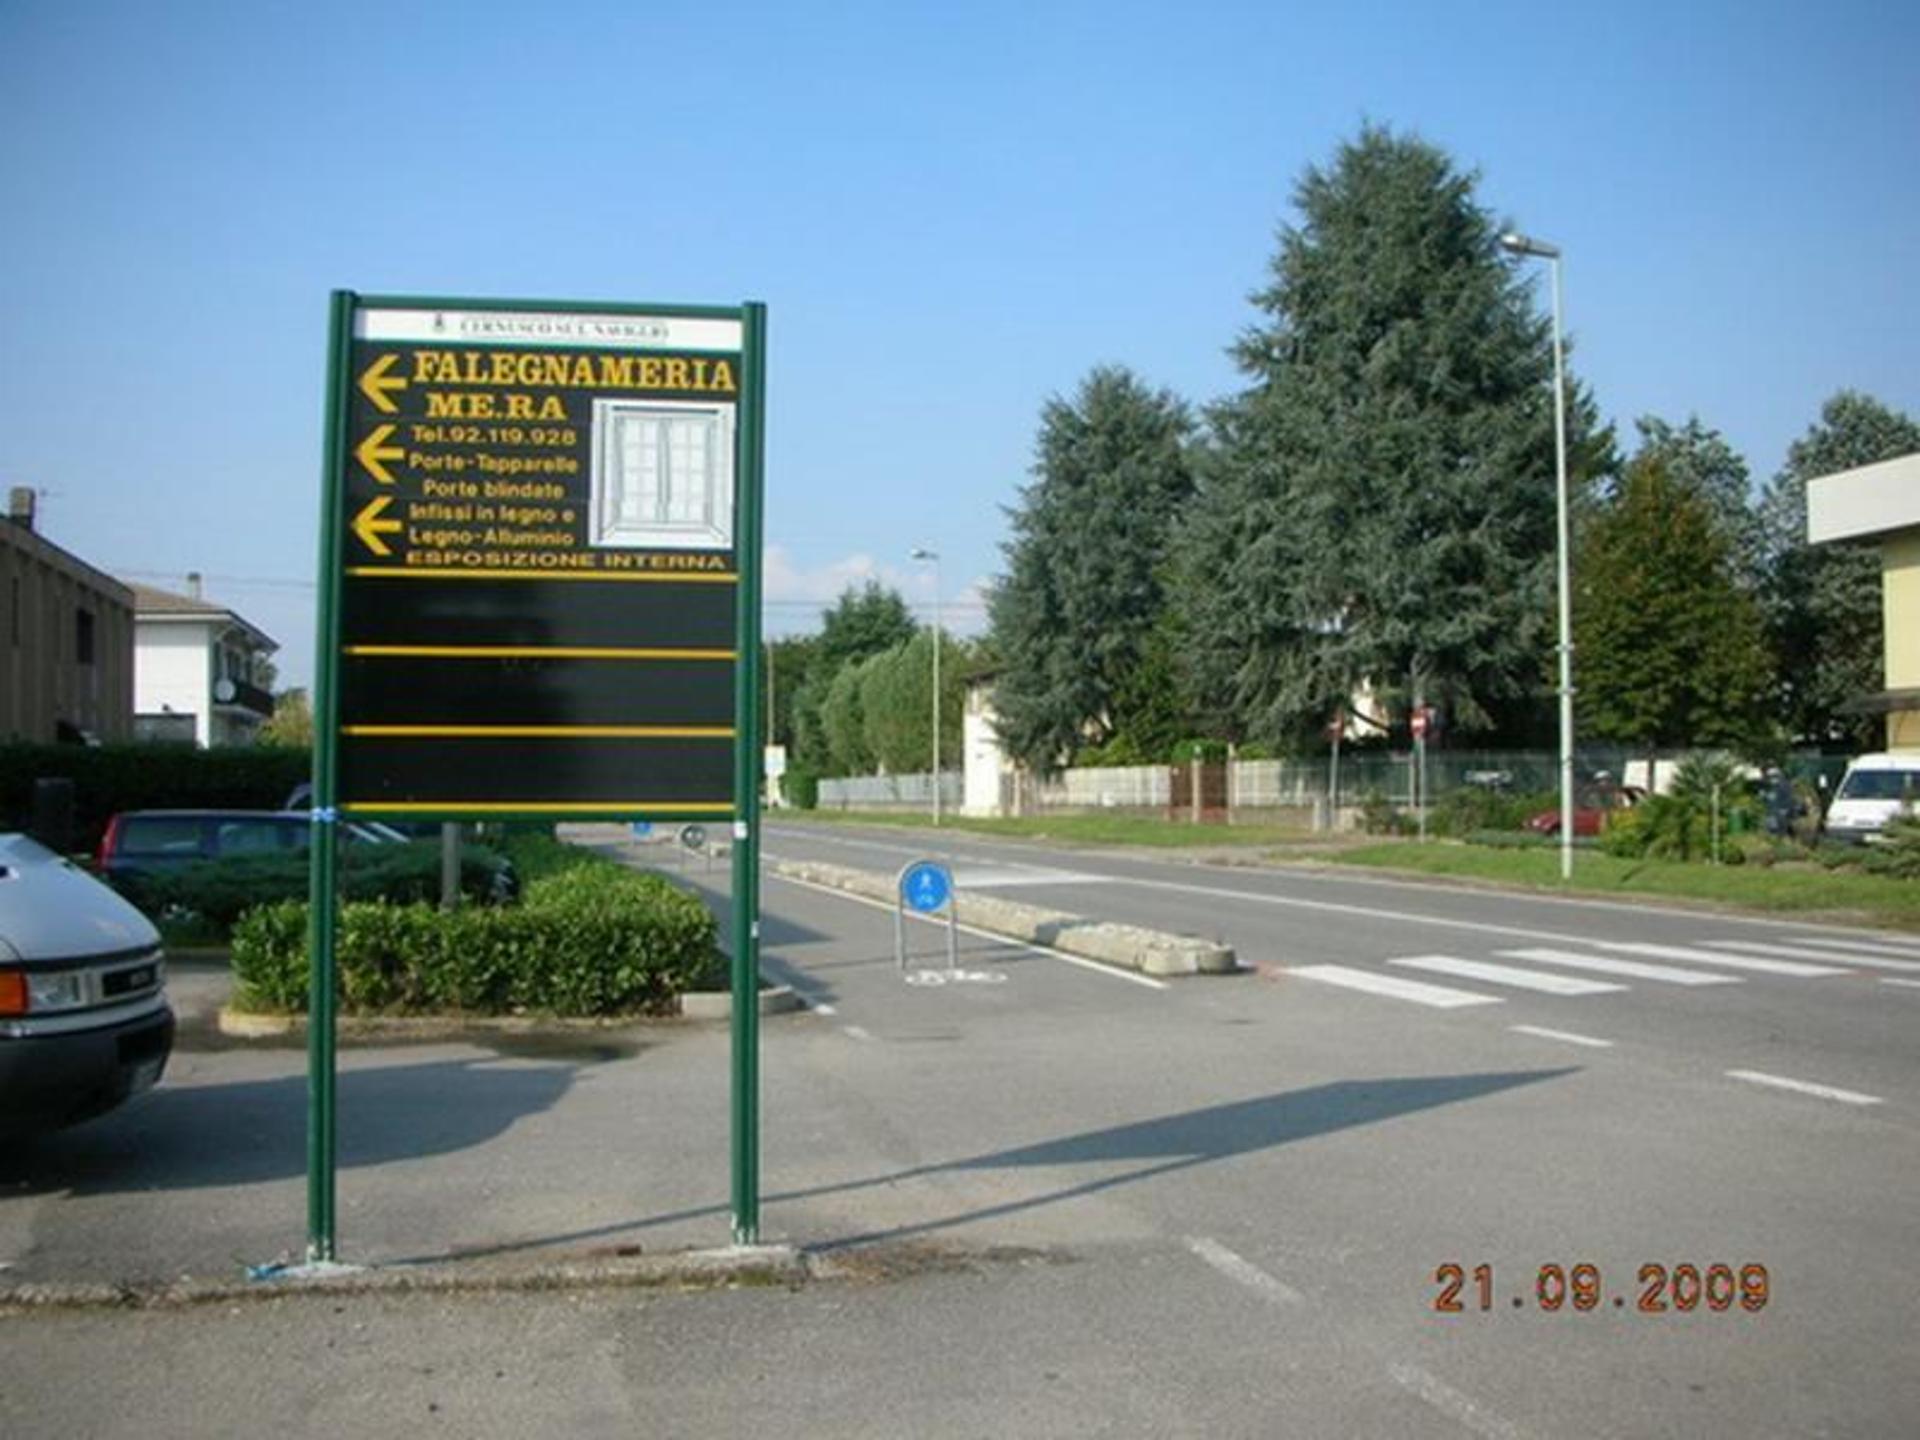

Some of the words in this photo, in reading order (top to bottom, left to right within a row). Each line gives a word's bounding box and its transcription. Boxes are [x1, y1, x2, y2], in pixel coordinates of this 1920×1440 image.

[413, 350, 737, 392] FALEGNAMERIA
[426, 394, 568, 421] ME.RA
[423, 478, 479, 499] Porte
[484, 481, 566, 500] blindate
[409, 503, 473, 521] Infissi
[477, 505, 496, 521] in
[501, 506, 556, 526] legno
[561, 510, 576, 523] e
[405, 550, 597, 568] ESPOSIZIONE
[603, 553, 726, 570] INTERNA
